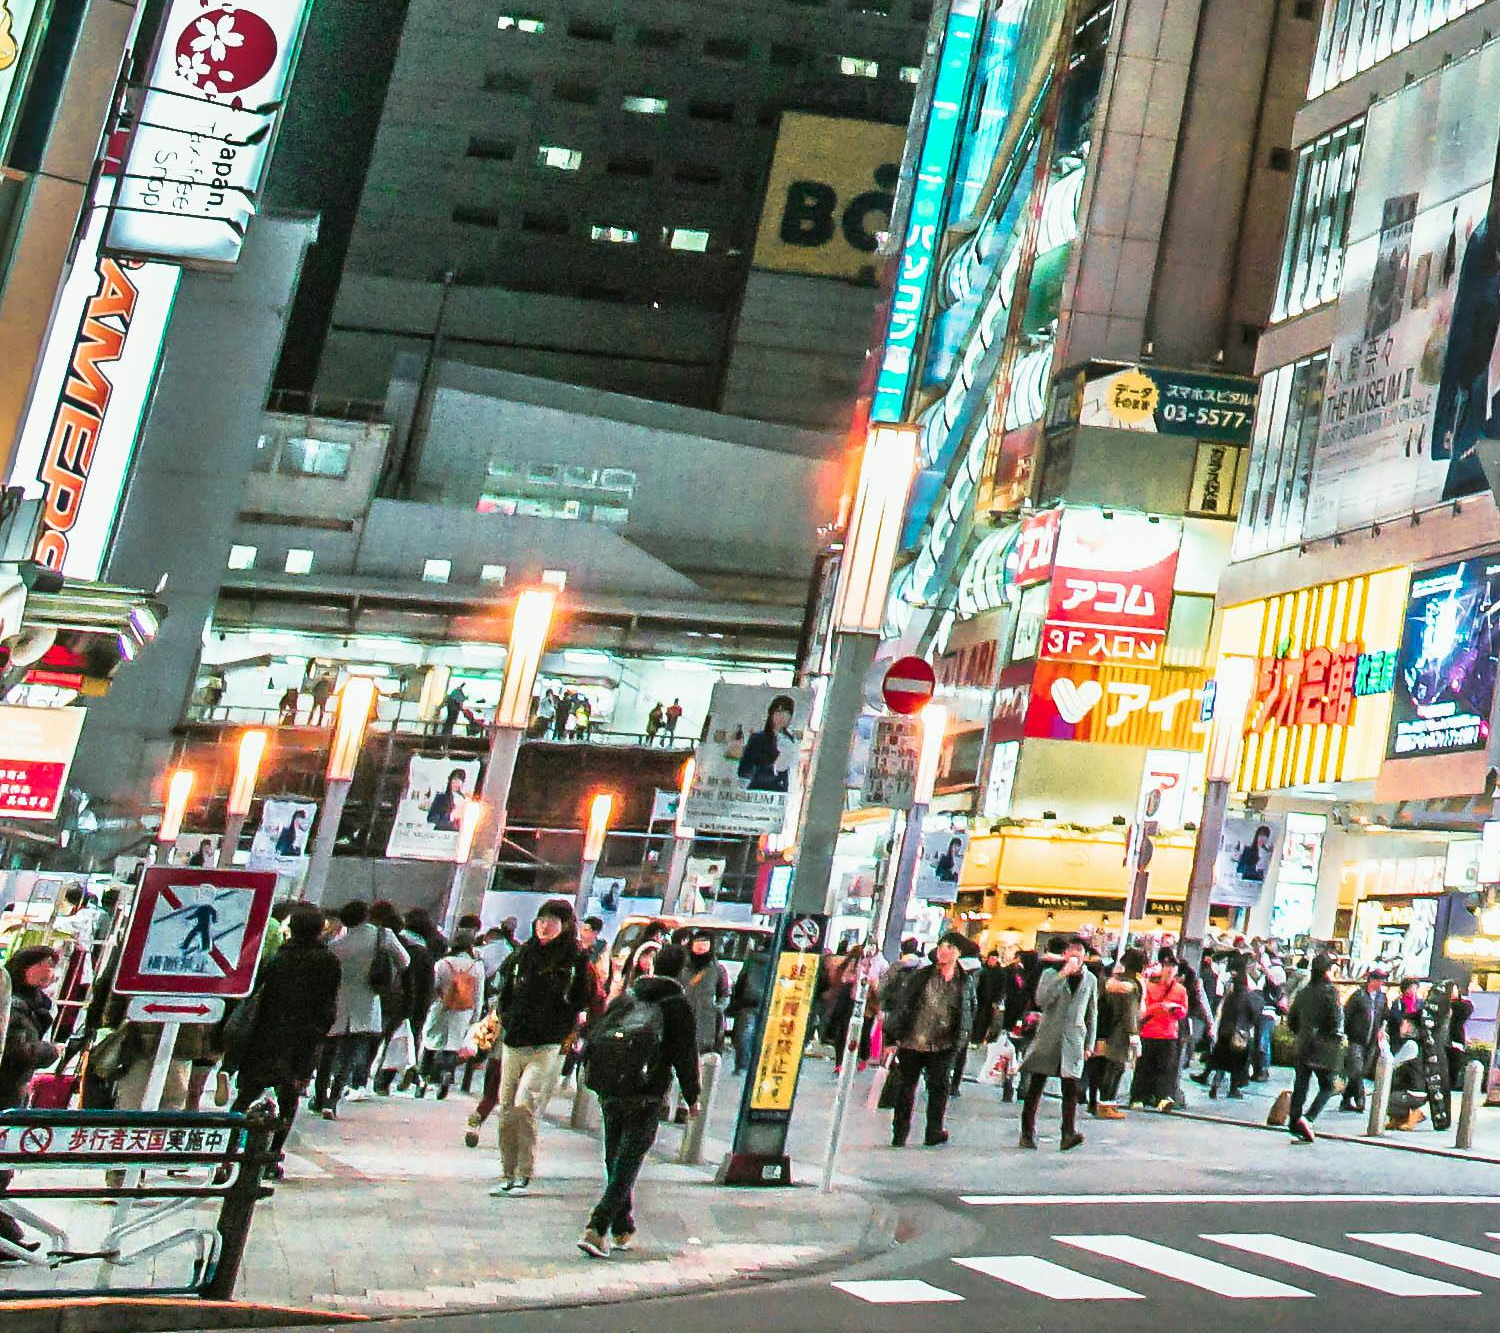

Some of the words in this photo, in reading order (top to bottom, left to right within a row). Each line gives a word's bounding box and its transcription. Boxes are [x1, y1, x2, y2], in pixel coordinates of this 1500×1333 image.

[1061, 578, 1156, 617] アコム
[1048, 629, 1086, 656] 3F
[1088, 631, 1140, 658] 入口
[67, 1128, 223, 1153] 歩行者天国実施中
